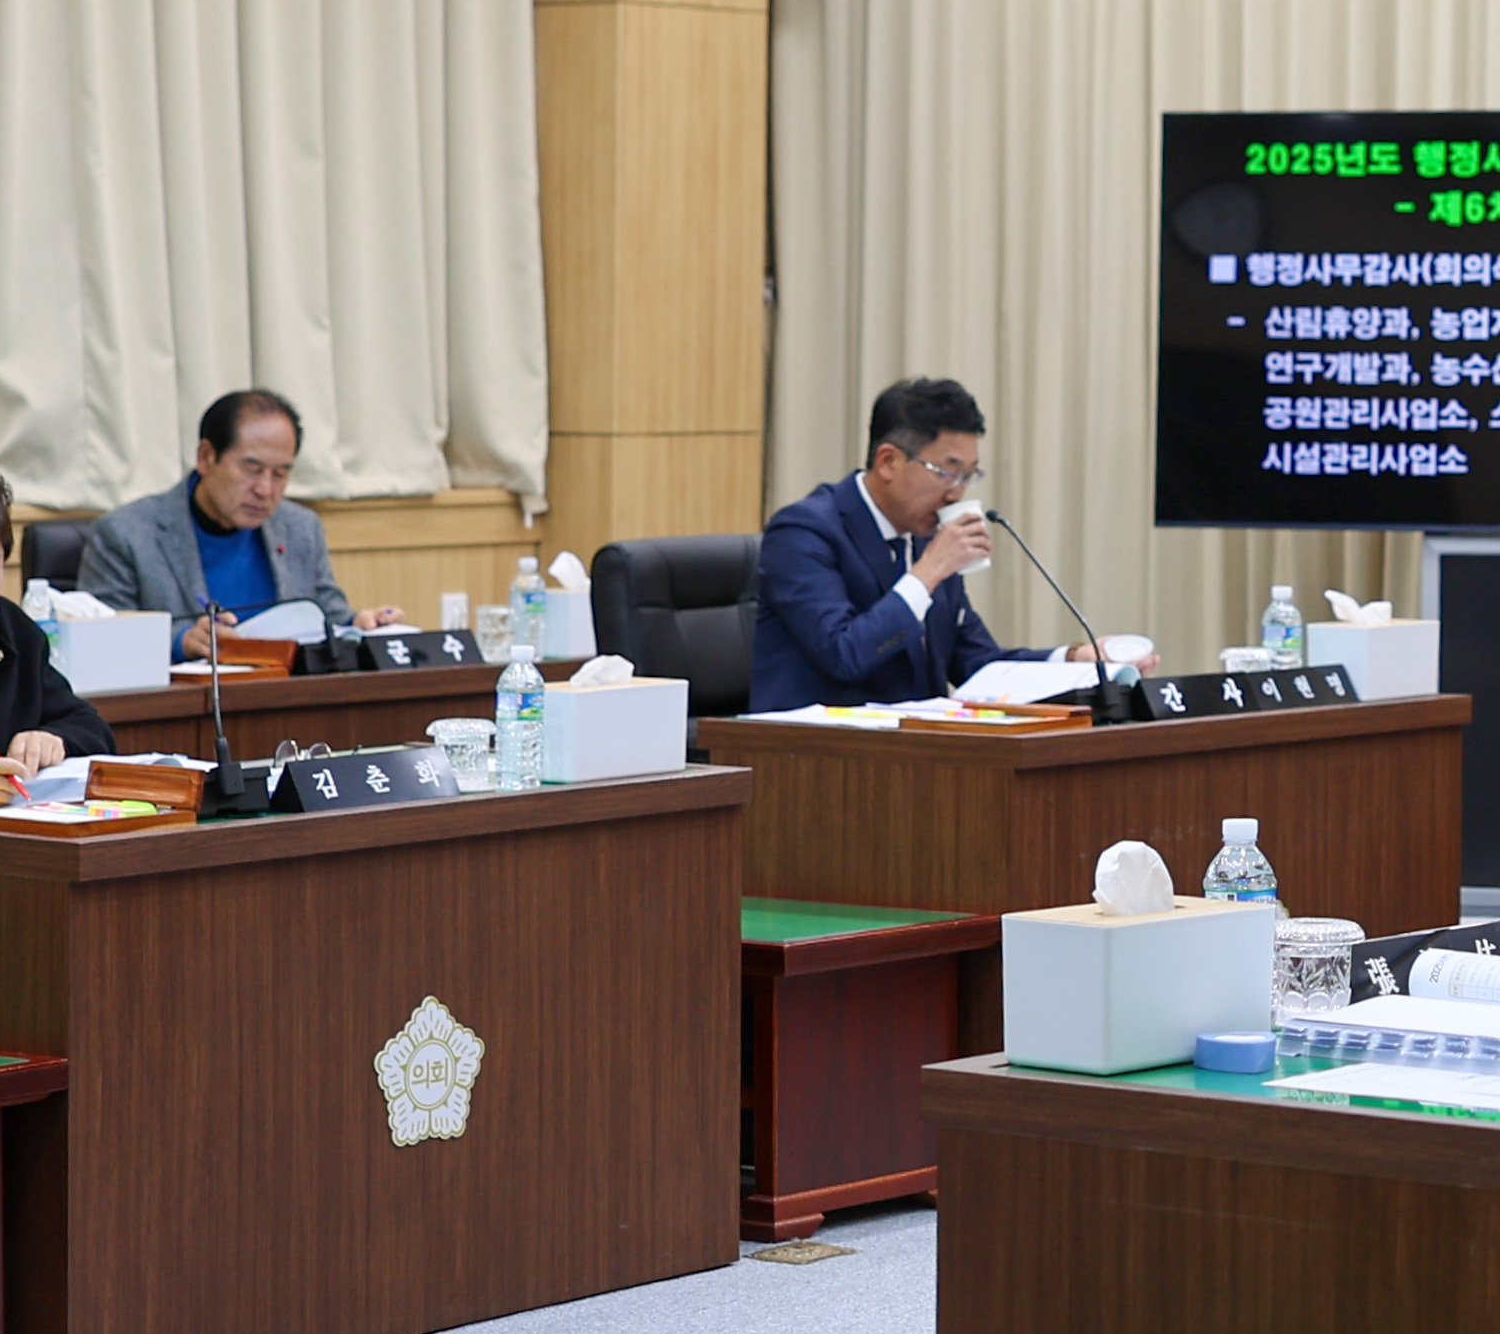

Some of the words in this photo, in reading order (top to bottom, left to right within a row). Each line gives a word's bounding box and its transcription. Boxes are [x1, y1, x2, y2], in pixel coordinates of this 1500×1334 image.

[1245, 141, 1402, 177] 2025년도
[1264, 305, 1421, 341] 산림휴양과,
[1264, 351, 1421, 386] 연구개발과,
[1263, 396, 1479, 432] 공원관리사업소,
[1261, 441, 1470, 477] 시설관리사업소
[411, 1057, 449, 1089] 의회
